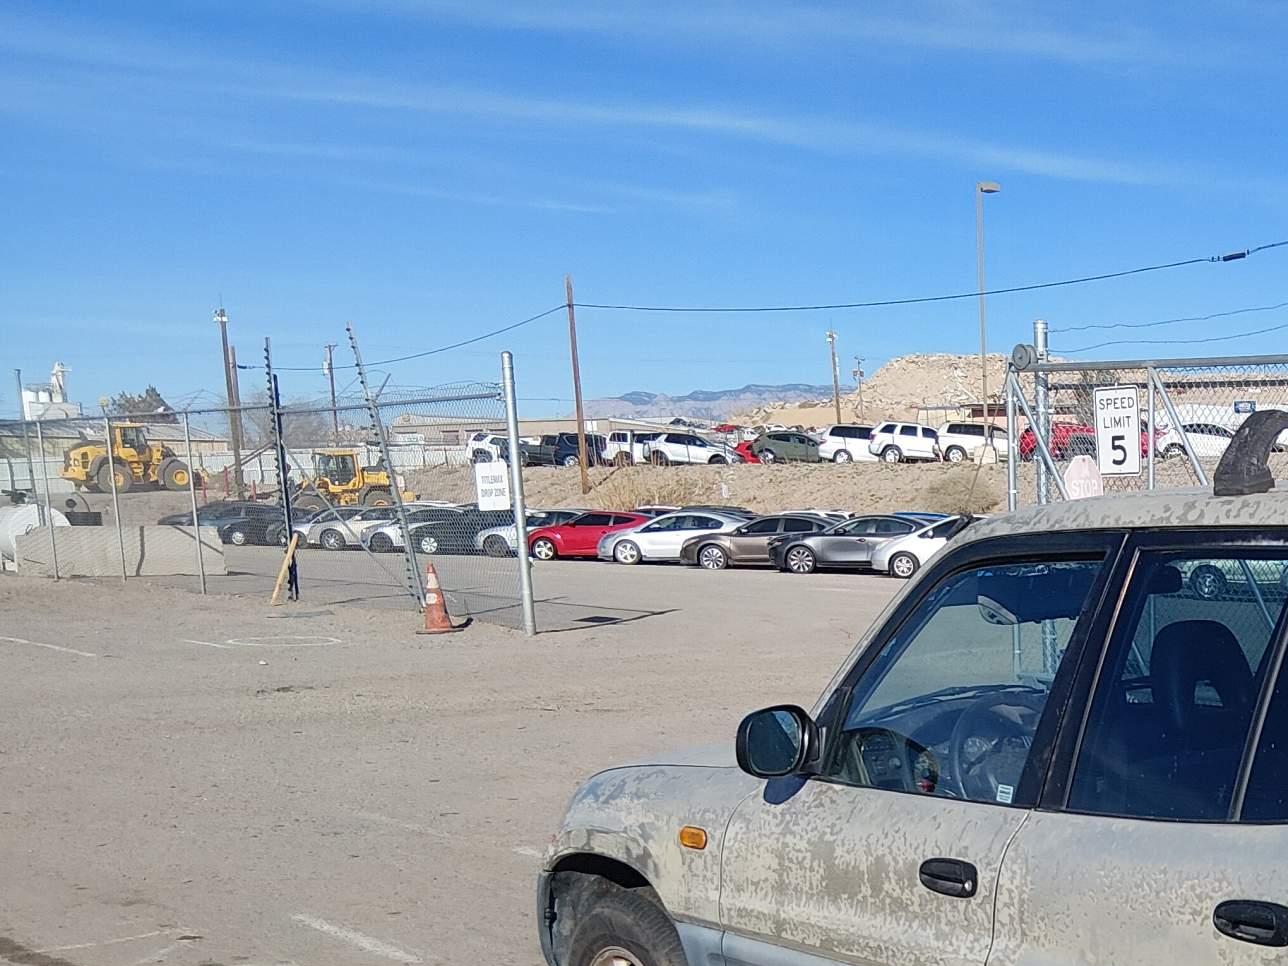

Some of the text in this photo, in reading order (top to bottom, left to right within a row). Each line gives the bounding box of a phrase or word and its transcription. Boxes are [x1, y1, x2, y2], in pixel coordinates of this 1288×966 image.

[1099, 397, 1135, 410] SPEED
[1103, 416, 1131, 429] LIMIT
[1111, 435, 1128, 466] 5
[1072, 480, 1098, 496] STOP
